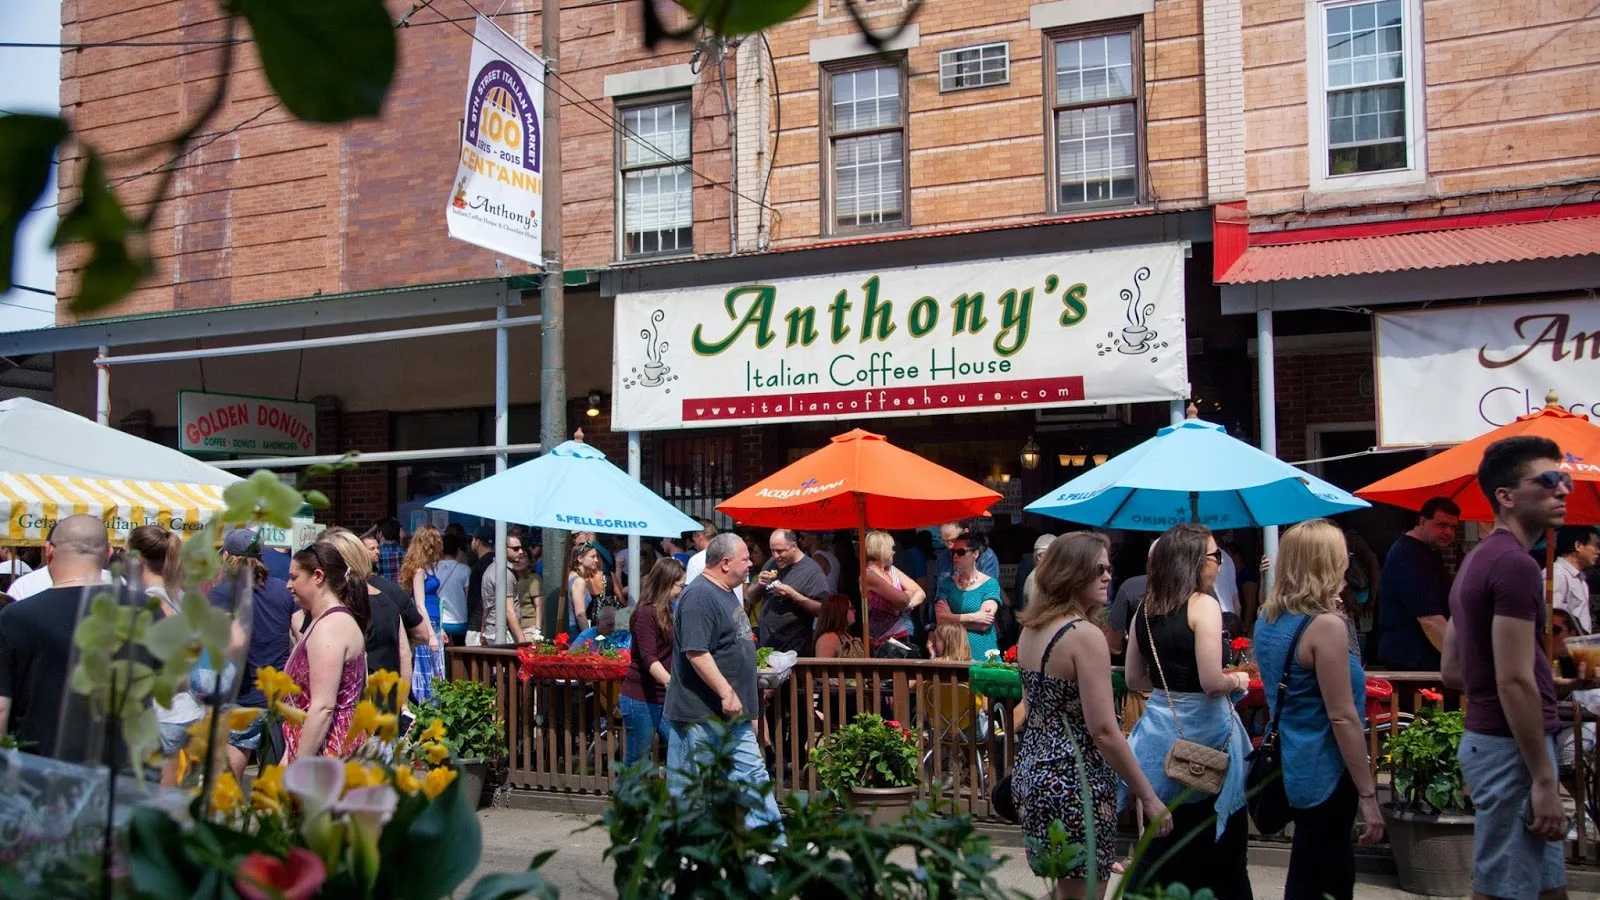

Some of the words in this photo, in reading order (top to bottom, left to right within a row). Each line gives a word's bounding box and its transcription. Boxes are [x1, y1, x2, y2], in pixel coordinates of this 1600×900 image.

[471, 96, 480, 123] 9TH
[477, 69, 501, 95] STREET
[502, 71, 528, 110] ITALIAN
[524, 112, 536, 167] MARKET
[480, 107, 521, 149] 100
[477, 139, 491, 154] 1915
[499, 150, 521, 165] 2015
[469, 195, 538, 230] Anthony's
[691, 274, 1088, 357] Anthony's
[747, 358, 819, 391] Italian
[829, 352, 919, 387] Coffee
[929, 347, 1012, 380] House
[695, 387, 1070, 416] www.italiancoffeehouse.com
[186, 403, 249, 444] GOLDEN
[257, 404, 313, 450] DONUTS
[204, 437, 226, 447] COFFEE
[233, 439, 256, 448] DONUTS
[263, 440, 298, 451] SANDWICHES
[755, 487, 801, 499] ACQUA
[18, 513, 57, 529] Gela
[103, 516, 139, 530] alian
[169, 517, 208, 531] Crea
[556, 513, 648, 529] S.PELLEGRINO
